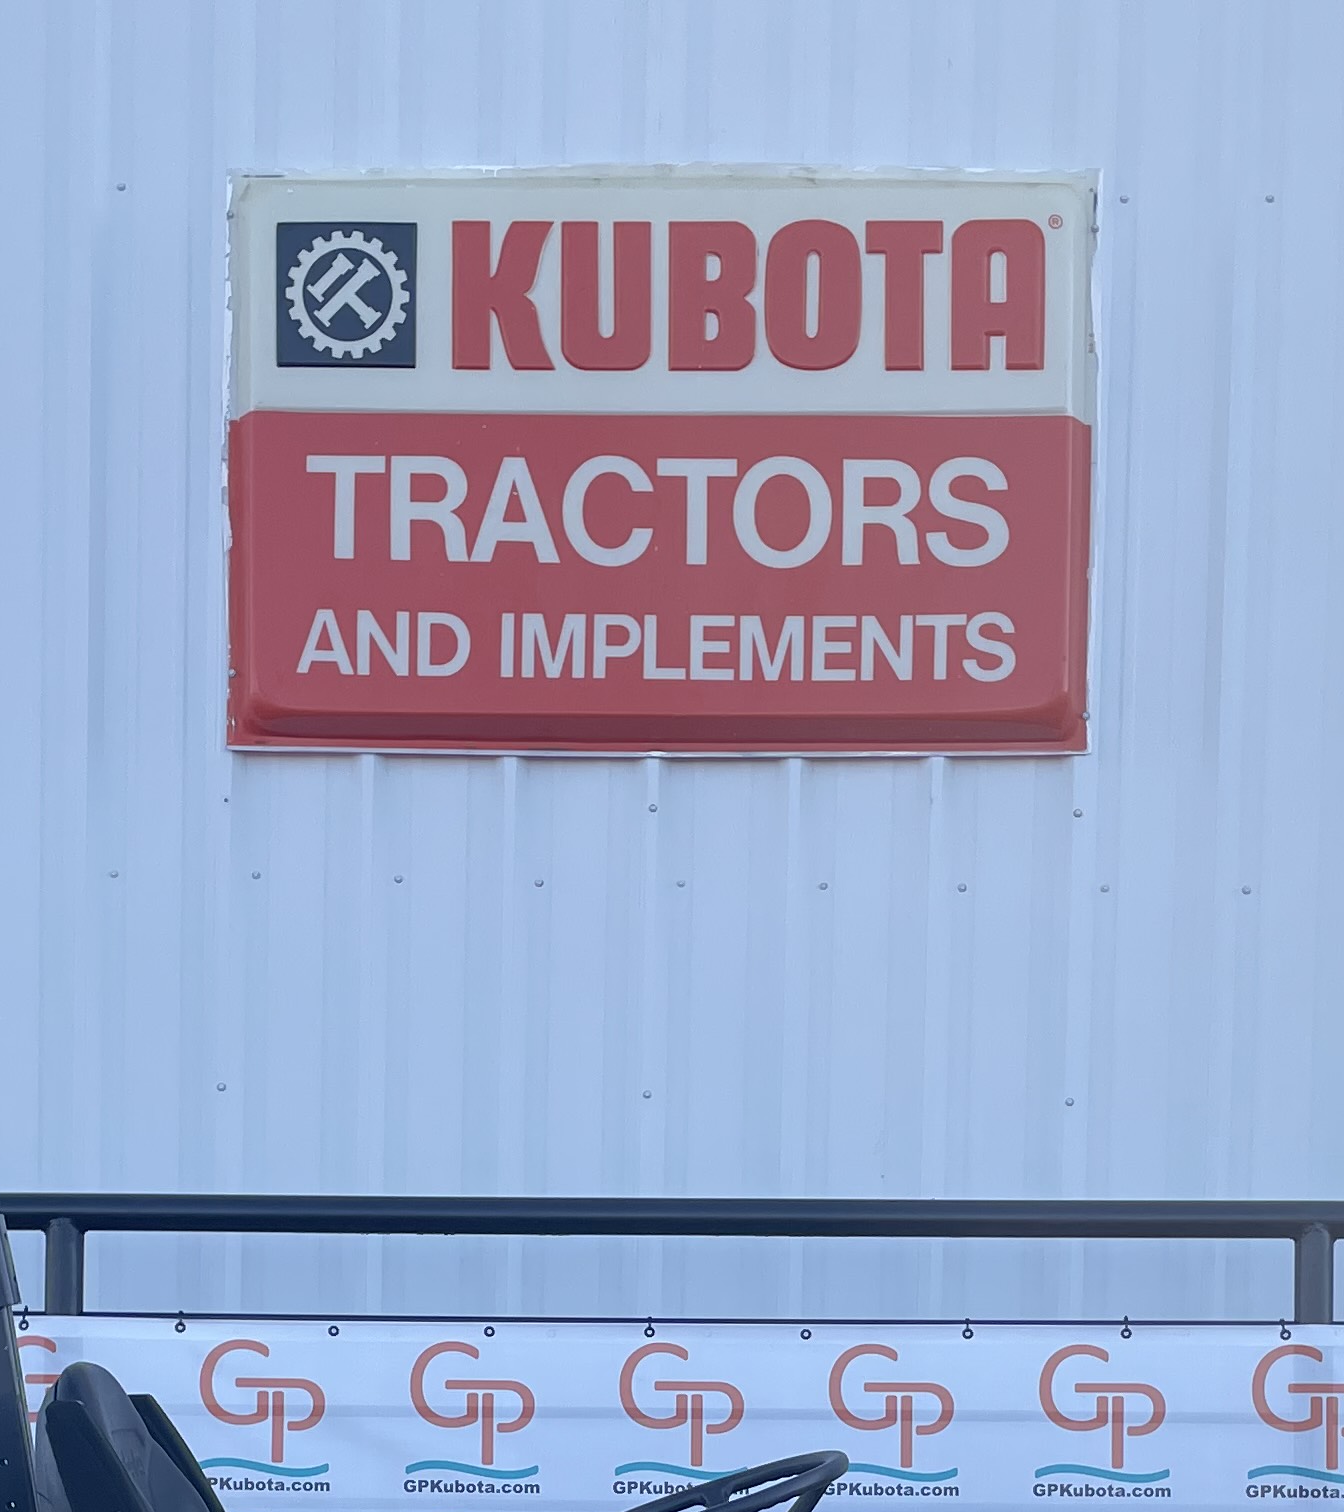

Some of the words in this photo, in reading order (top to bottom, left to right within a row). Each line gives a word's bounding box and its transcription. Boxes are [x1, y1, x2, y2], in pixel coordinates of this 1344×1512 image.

[305, 455, 1010, 569] TRACTORS
[296, 610, 471, 679] AND
[500, 611, 1016, 684] IMPLEMENTS
[200, 1340, 325, 1463] GP
[411, 1341, 535, 1465] GP
[620, 1343, 744, 1467] GP
[829, 1344, 953, 1468] GP
[1040, 1344, 1165, 1469] GP
[207, 1477, 330, 1492] PKubota.com
[404, 1480, 540, 1493] GPKubota.com
[1033, 1484, 1171, 1497] GPKubota.com
